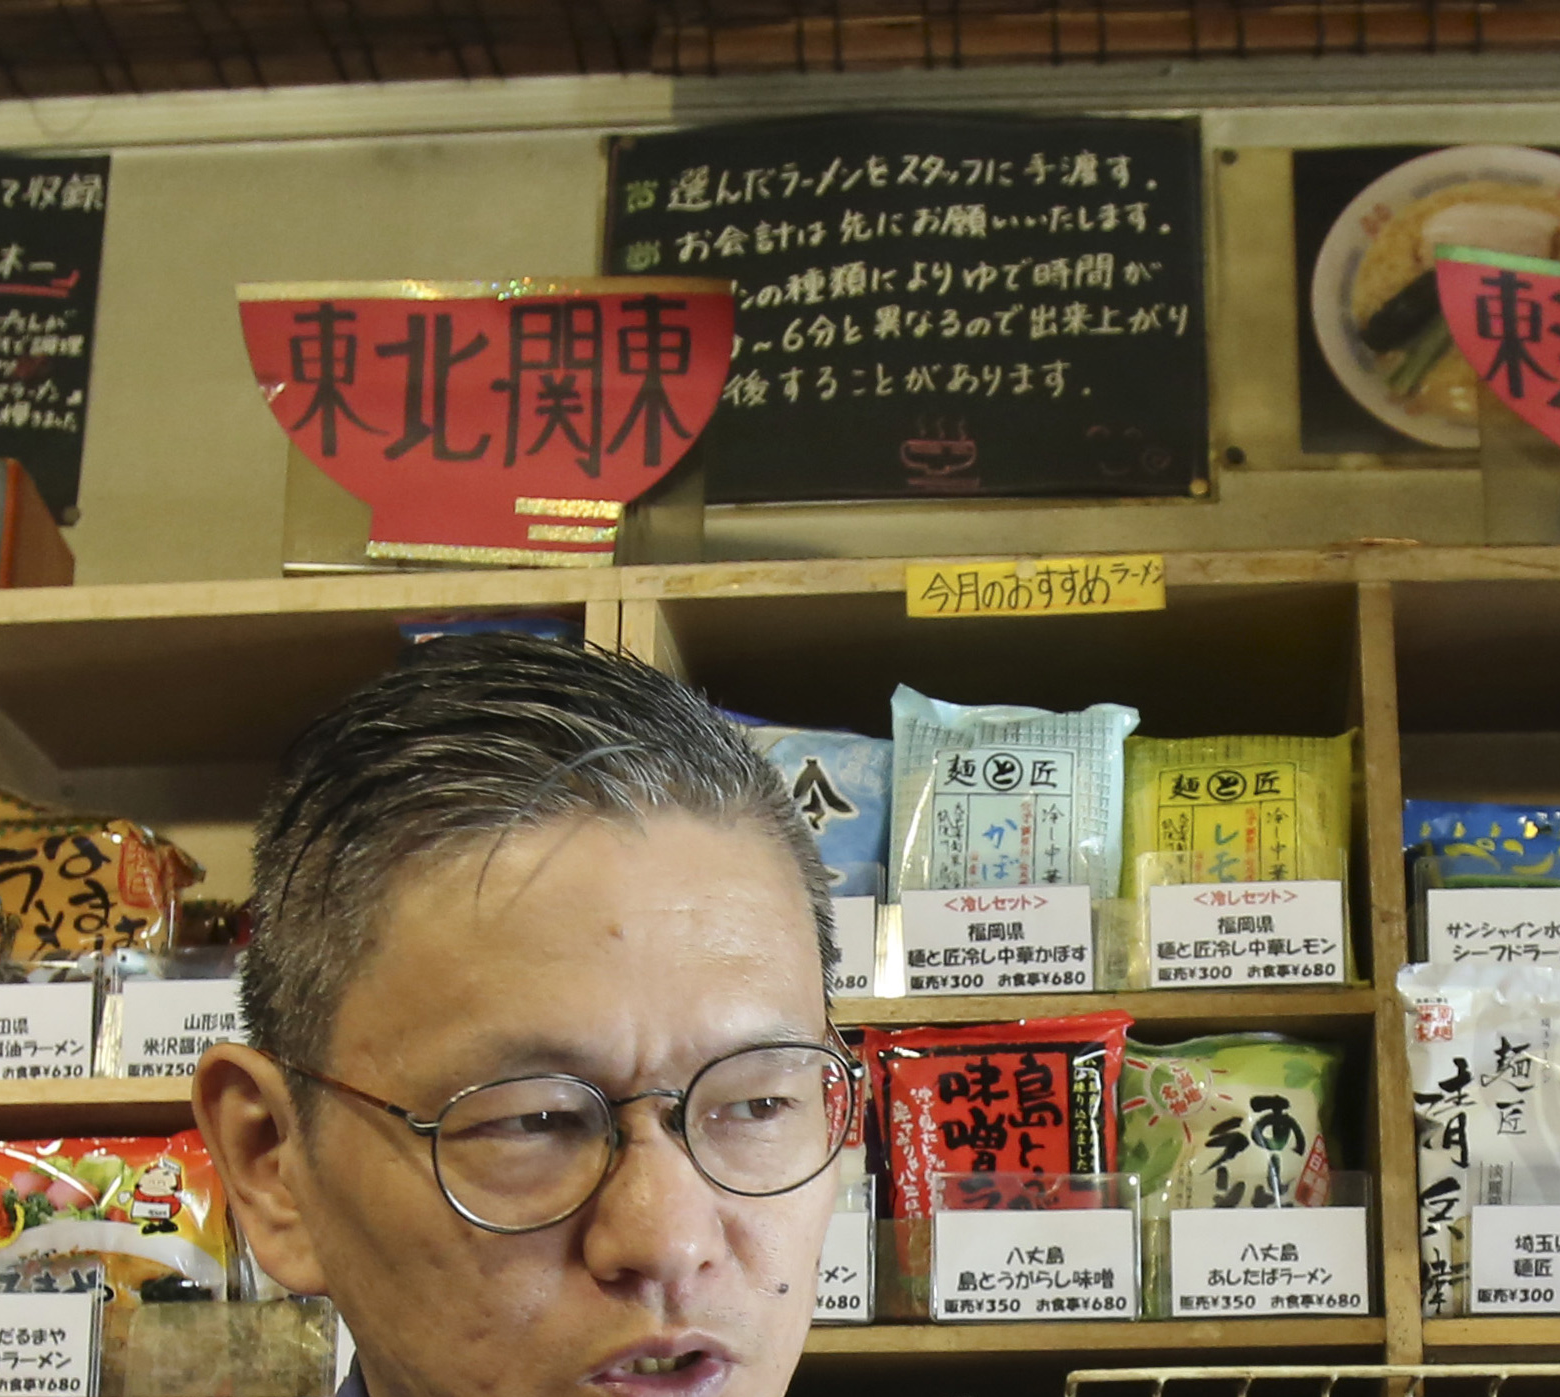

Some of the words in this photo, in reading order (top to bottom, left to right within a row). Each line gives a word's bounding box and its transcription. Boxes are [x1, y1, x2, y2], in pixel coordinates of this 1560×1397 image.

[967, 921, 1025, 943] 福岡県
[1217, 915, 1275, 934] 福岡県
[907, 942, 1087, 967] 麺と匠冷し中華かぼす
[1157, 937, 1337, 960] 麺と匠冷し中華レモン
[184, 1013, 237, 1031] 山形県
[1007, 1245, 1065, 1267] 八丈島
[1241, 1244, 1299, 1263] 八丈島
[1207, 1267, 1333, 1287] あしたばラーメン
[1514, 1259, 1553, 1277] 麺匠
[957, 1270, 1115, 1291] 島とうがらし味噌
